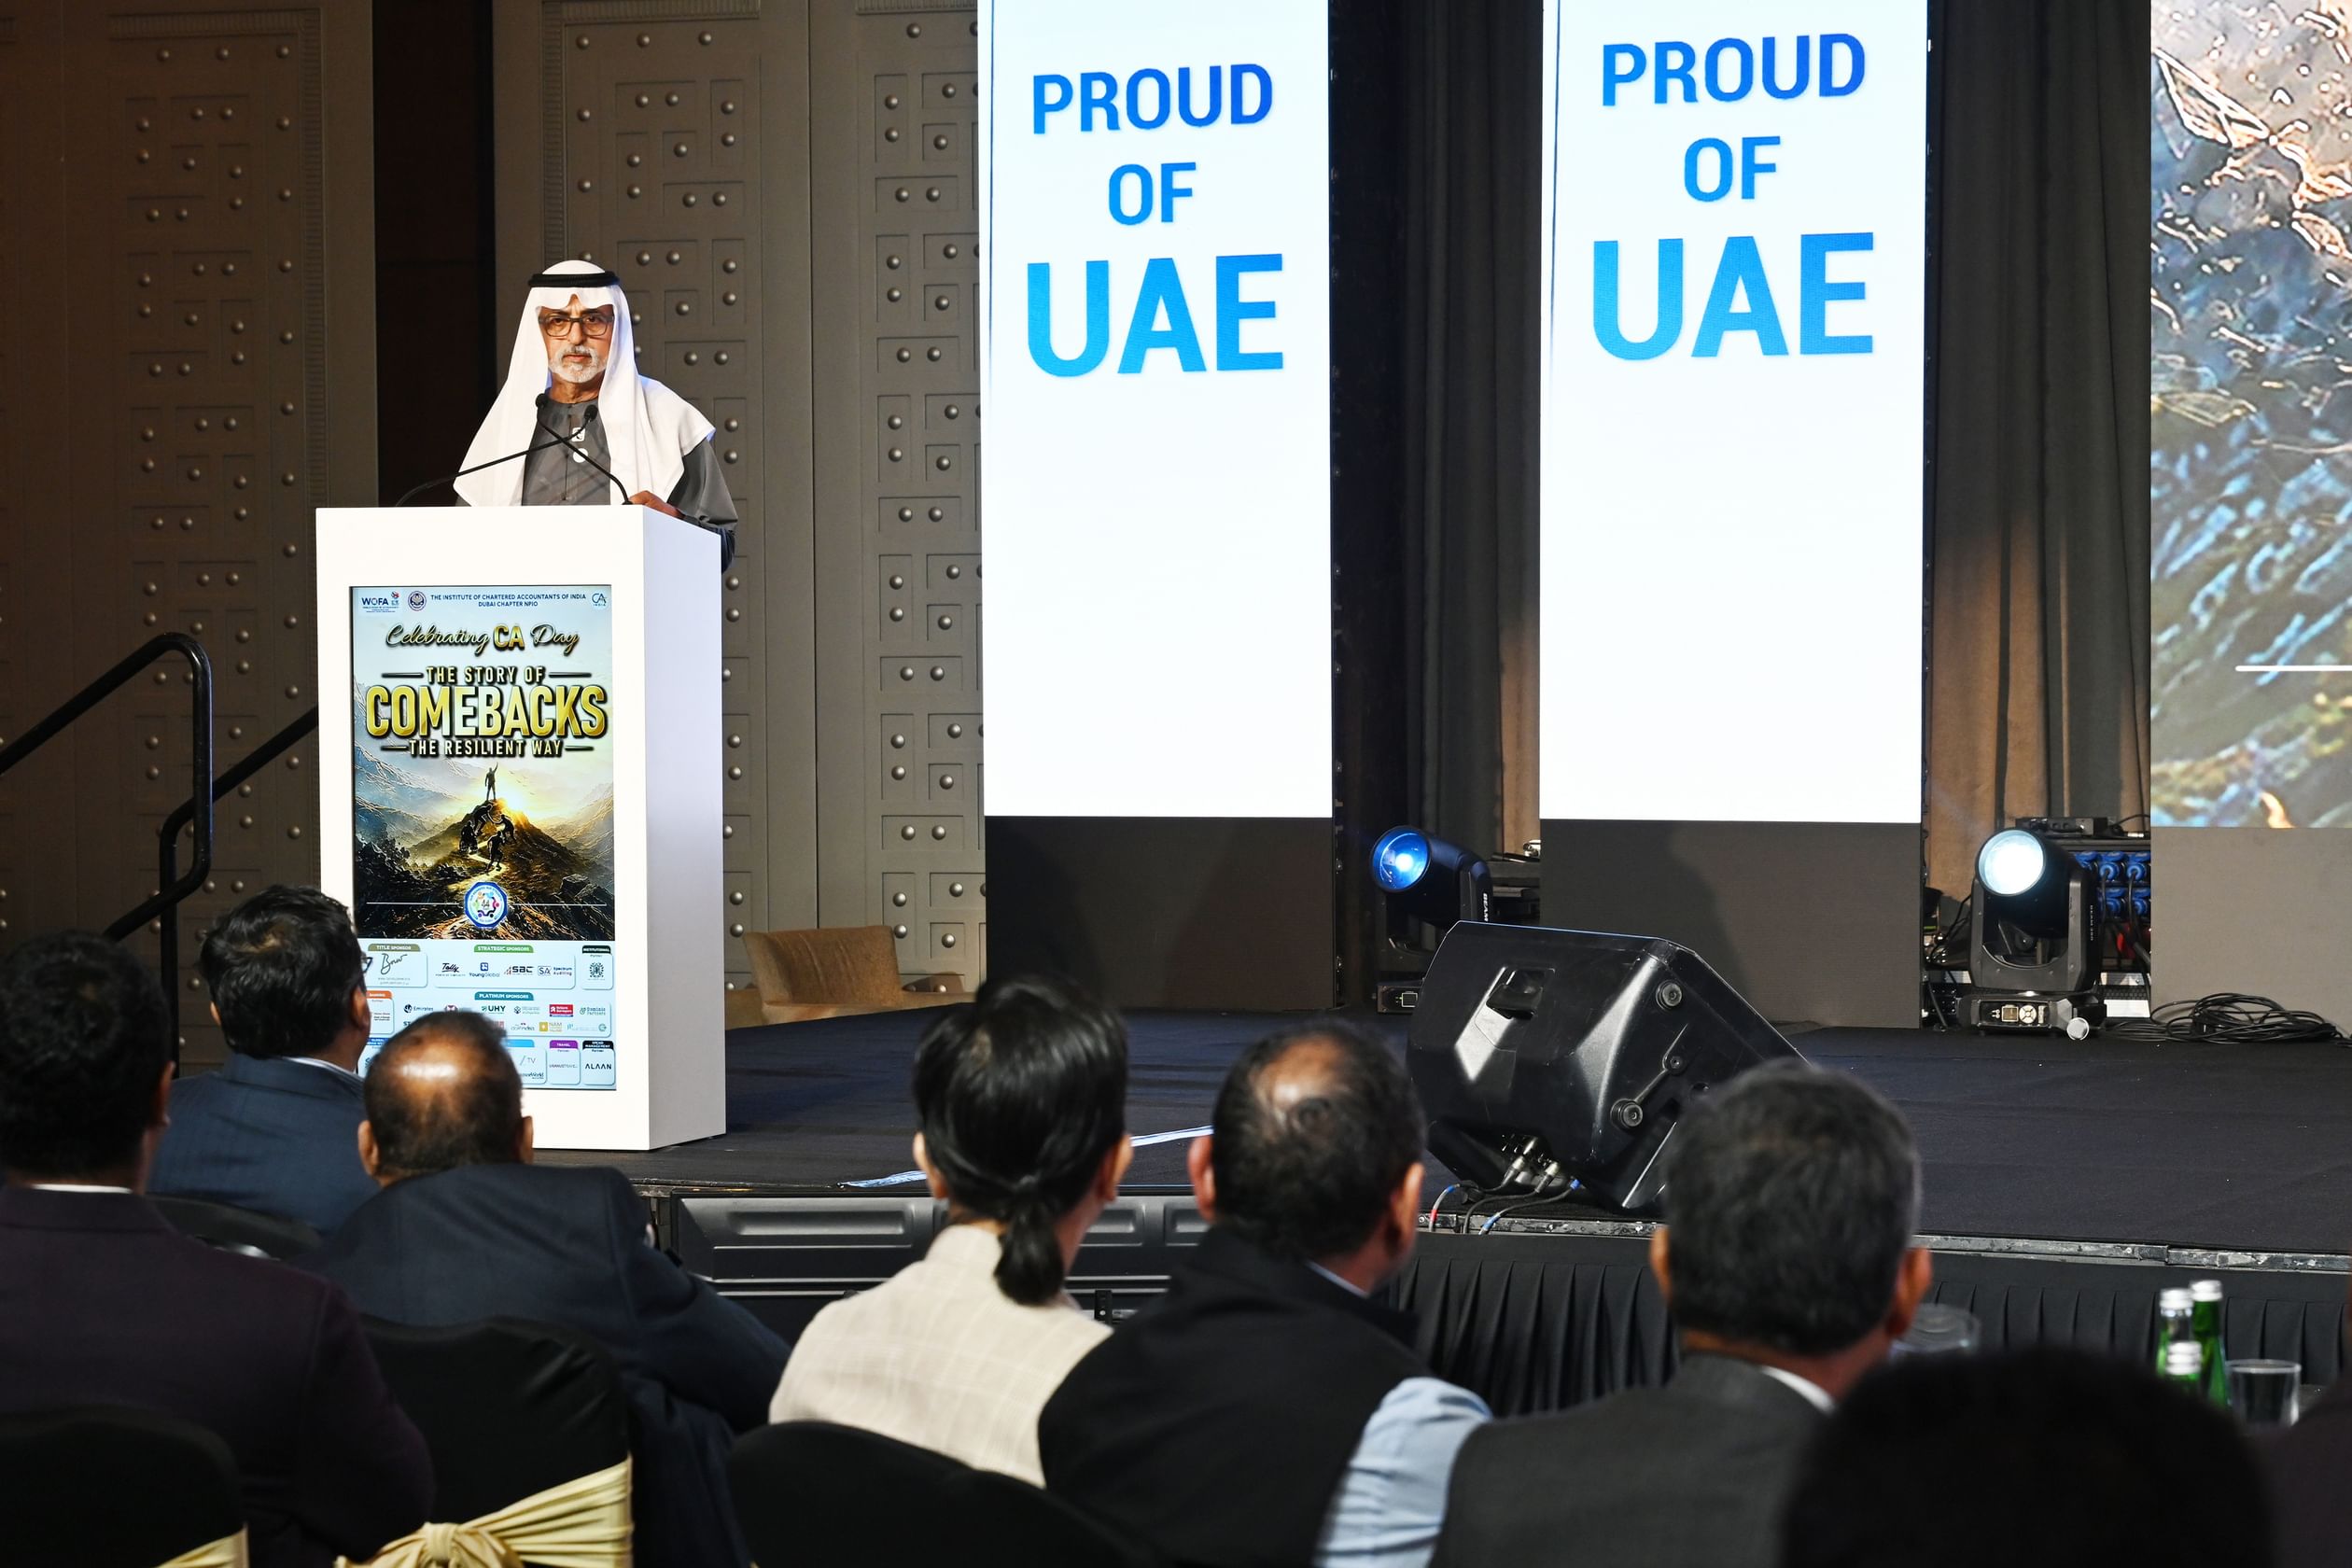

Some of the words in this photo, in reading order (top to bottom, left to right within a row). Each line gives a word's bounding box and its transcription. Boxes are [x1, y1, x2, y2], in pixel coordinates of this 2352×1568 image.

[1603, 34, 1866, 106] PROUD
[1033, 63, 1273, 134] PROUD
[1109, 161, 1197, 226] OF
[1684, 135, 1781, 203] OF
[1027, 253, 1283, 378] UAE
[1593, 231, 1874, 361] UAE
[361, 597, 389, 606] WOFA
[591, 593, 607, 604] CA
[385, 623, 490, 656] Celebrating
[493, 623, 525, 651] CA
[530, 623, 580, 656] Day
[427, 666, 456, 683] THE
[465, 666, 515, 683] STORY
[525, 666, 546, 683] OF
[365, 685, 608, 737] COMEBACKS
[410, 739, 438, 756] THE
[444, 739, 526, 756] RESILIENT
[531, 739, 563, 756] WAY
[441, 962, 460, 973] Tally
